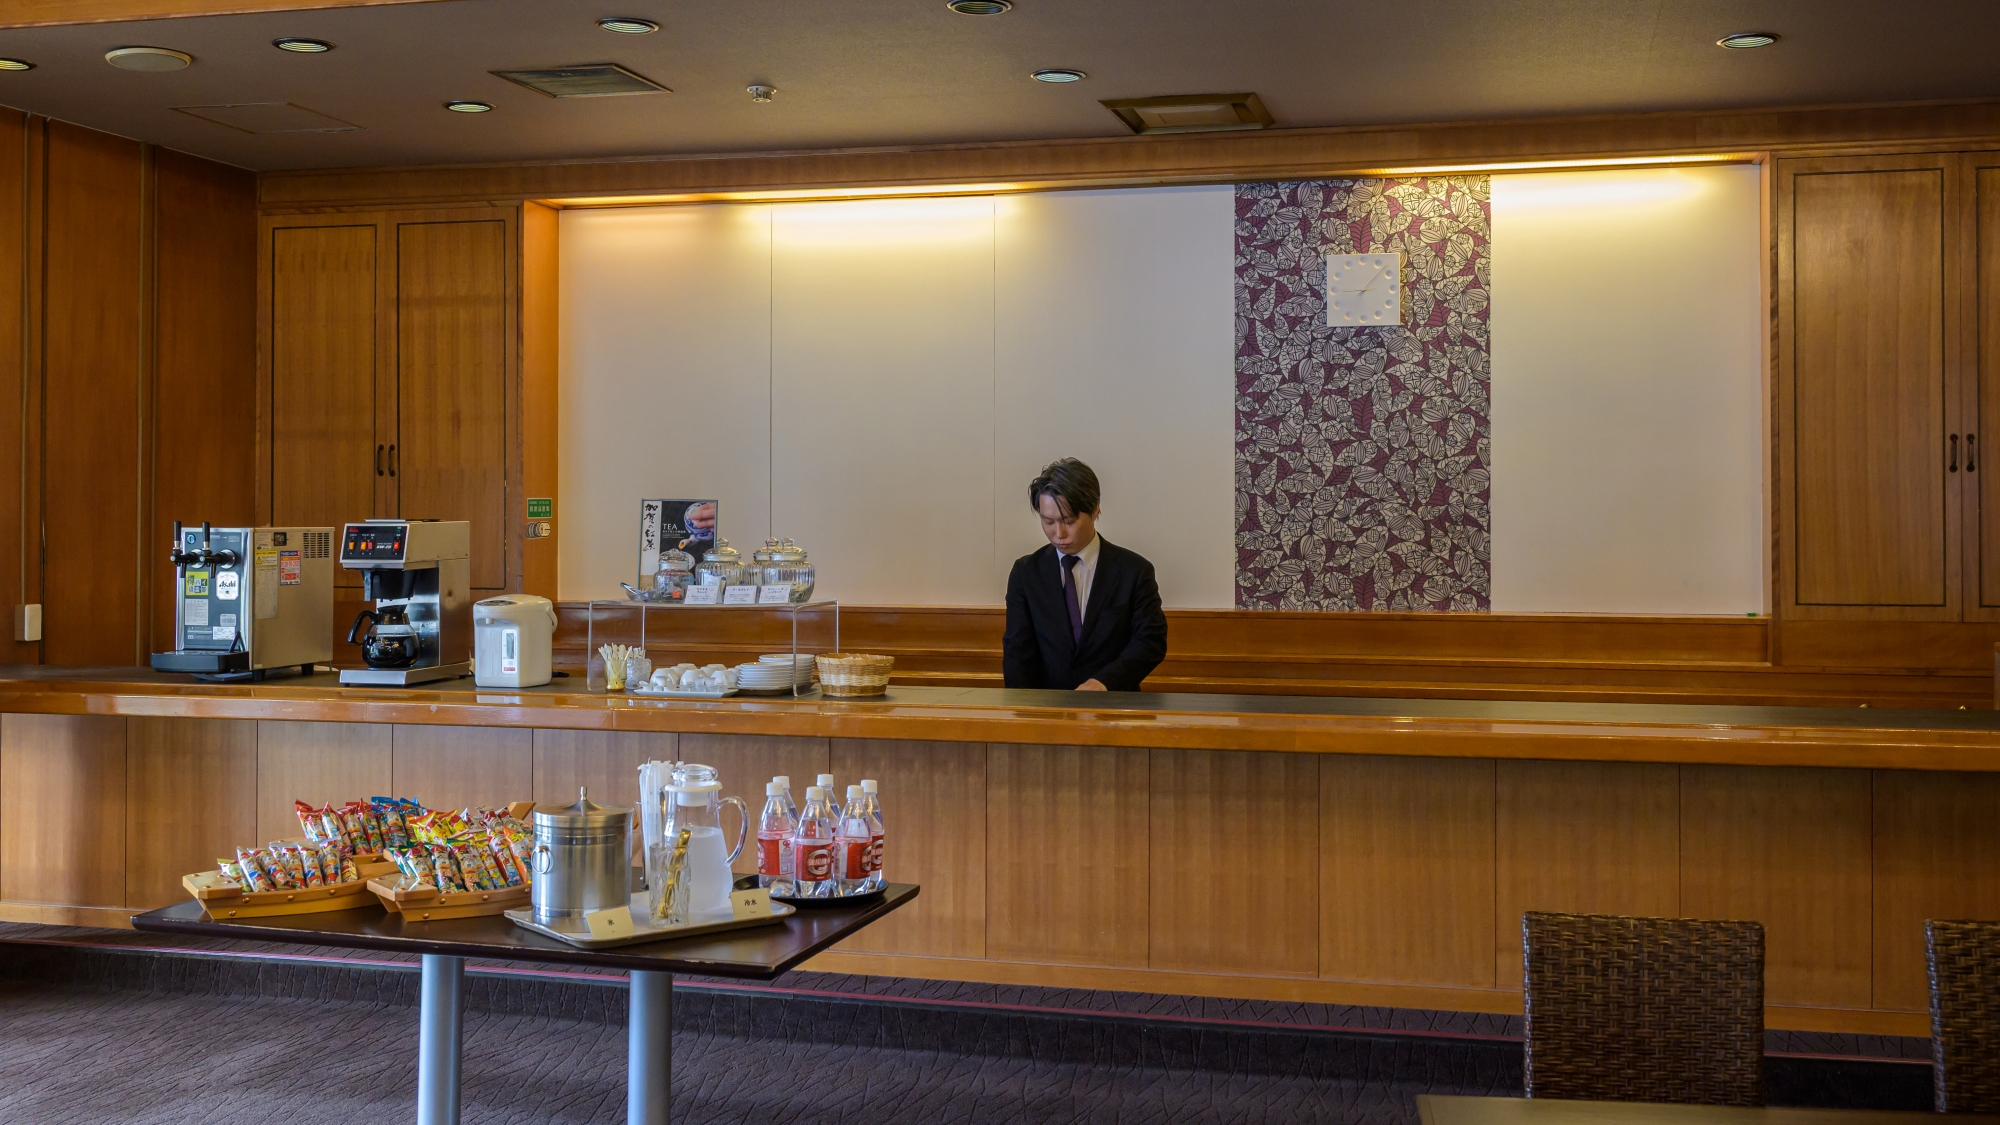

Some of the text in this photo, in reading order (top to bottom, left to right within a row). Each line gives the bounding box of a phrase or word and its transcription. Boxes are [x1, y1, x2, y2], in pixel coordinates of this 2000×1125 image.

[644, 503, 659, 551] 加賀の紅茶
[662, 523, 678, 531] TEA
[219, 580, 236, 588] Asahi
[744, 898, 757, 906] 冷水
